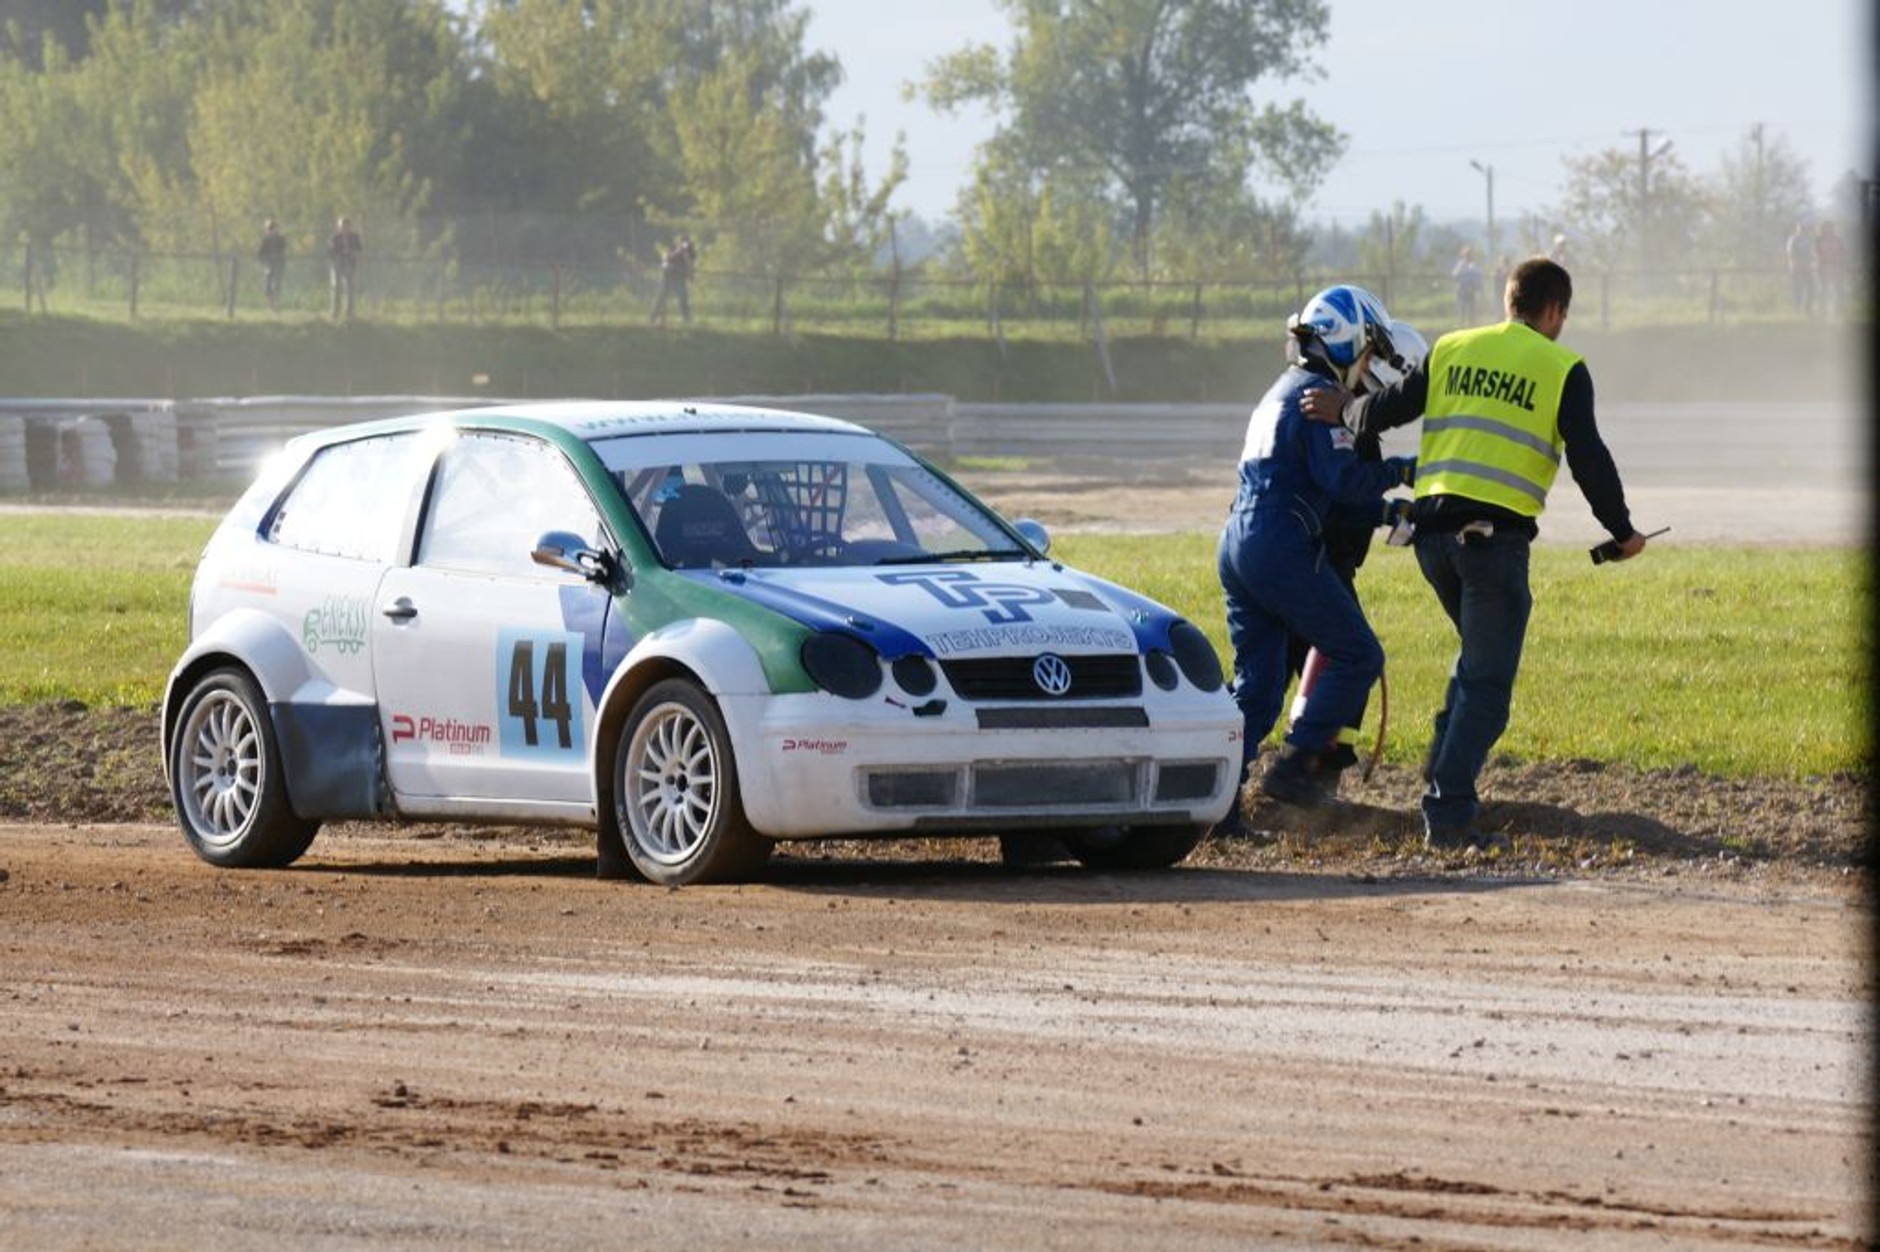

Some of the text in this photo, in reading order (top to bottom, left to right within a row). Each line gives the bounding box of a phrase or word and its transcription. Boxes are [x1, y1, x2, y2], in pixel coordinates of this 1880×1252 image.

[1445, 365, 1536, 412] MARSHAL
[508, 639, 572, 748] 44
[418, 717, 490, 744] Platinum
